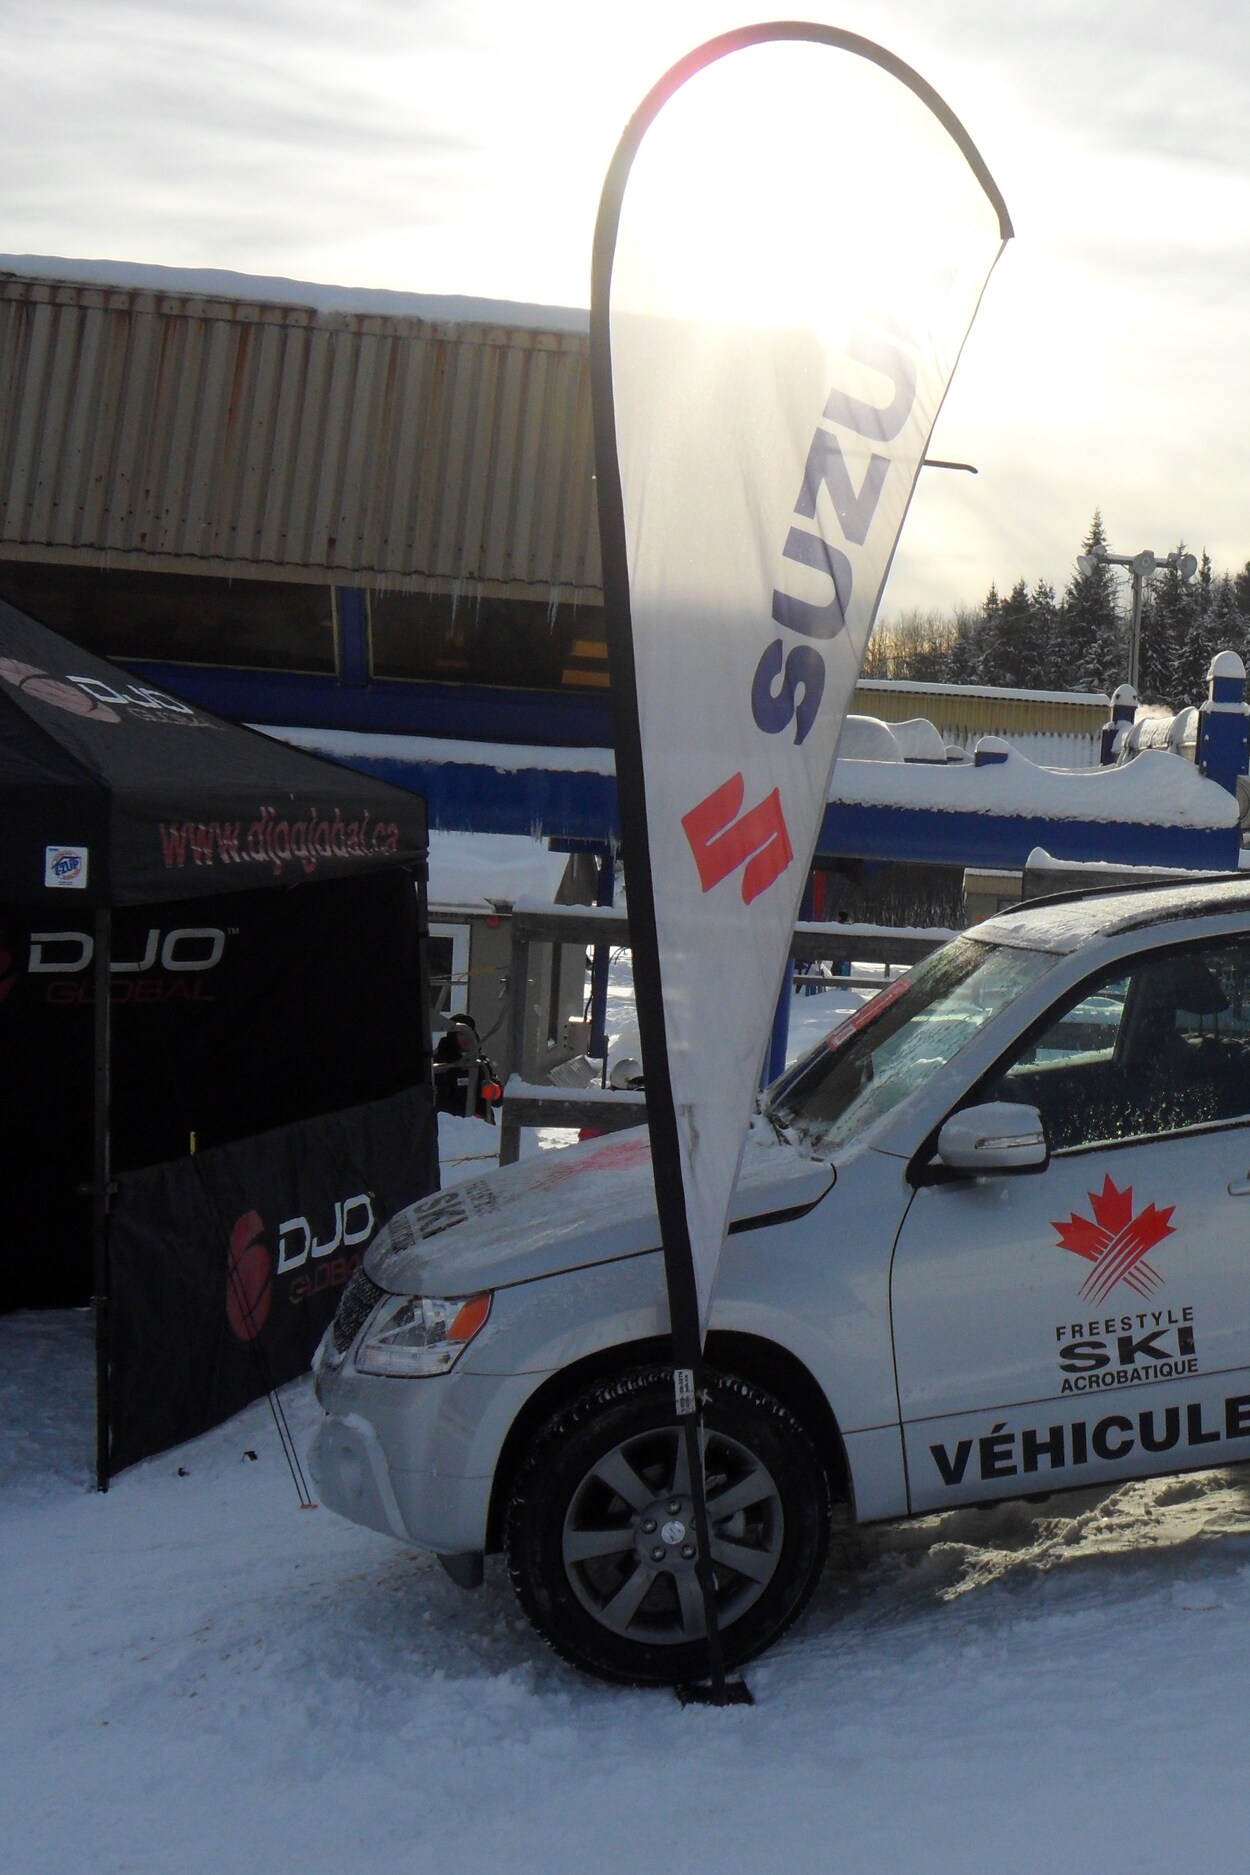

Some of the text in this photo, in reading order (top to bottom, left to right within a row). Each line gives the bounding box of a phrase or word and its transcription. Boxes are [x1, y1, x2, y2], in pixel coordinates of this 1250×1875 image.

[752, 312, 921, 746] SUZU
[159, 806, 400, 876] www.djoglobal.ca
[28, 928, 226, 973] DJO
[276, 1194, 374, 1275] DJO
[289, 1254, 363, 1305] GLOBA
[1055, 1306, 1195, 1341] FREESTYLE
[1058, 1326, 1197, 1374] SKI
[1060, 1357, 1200, 1394] ACROBATIQUE
